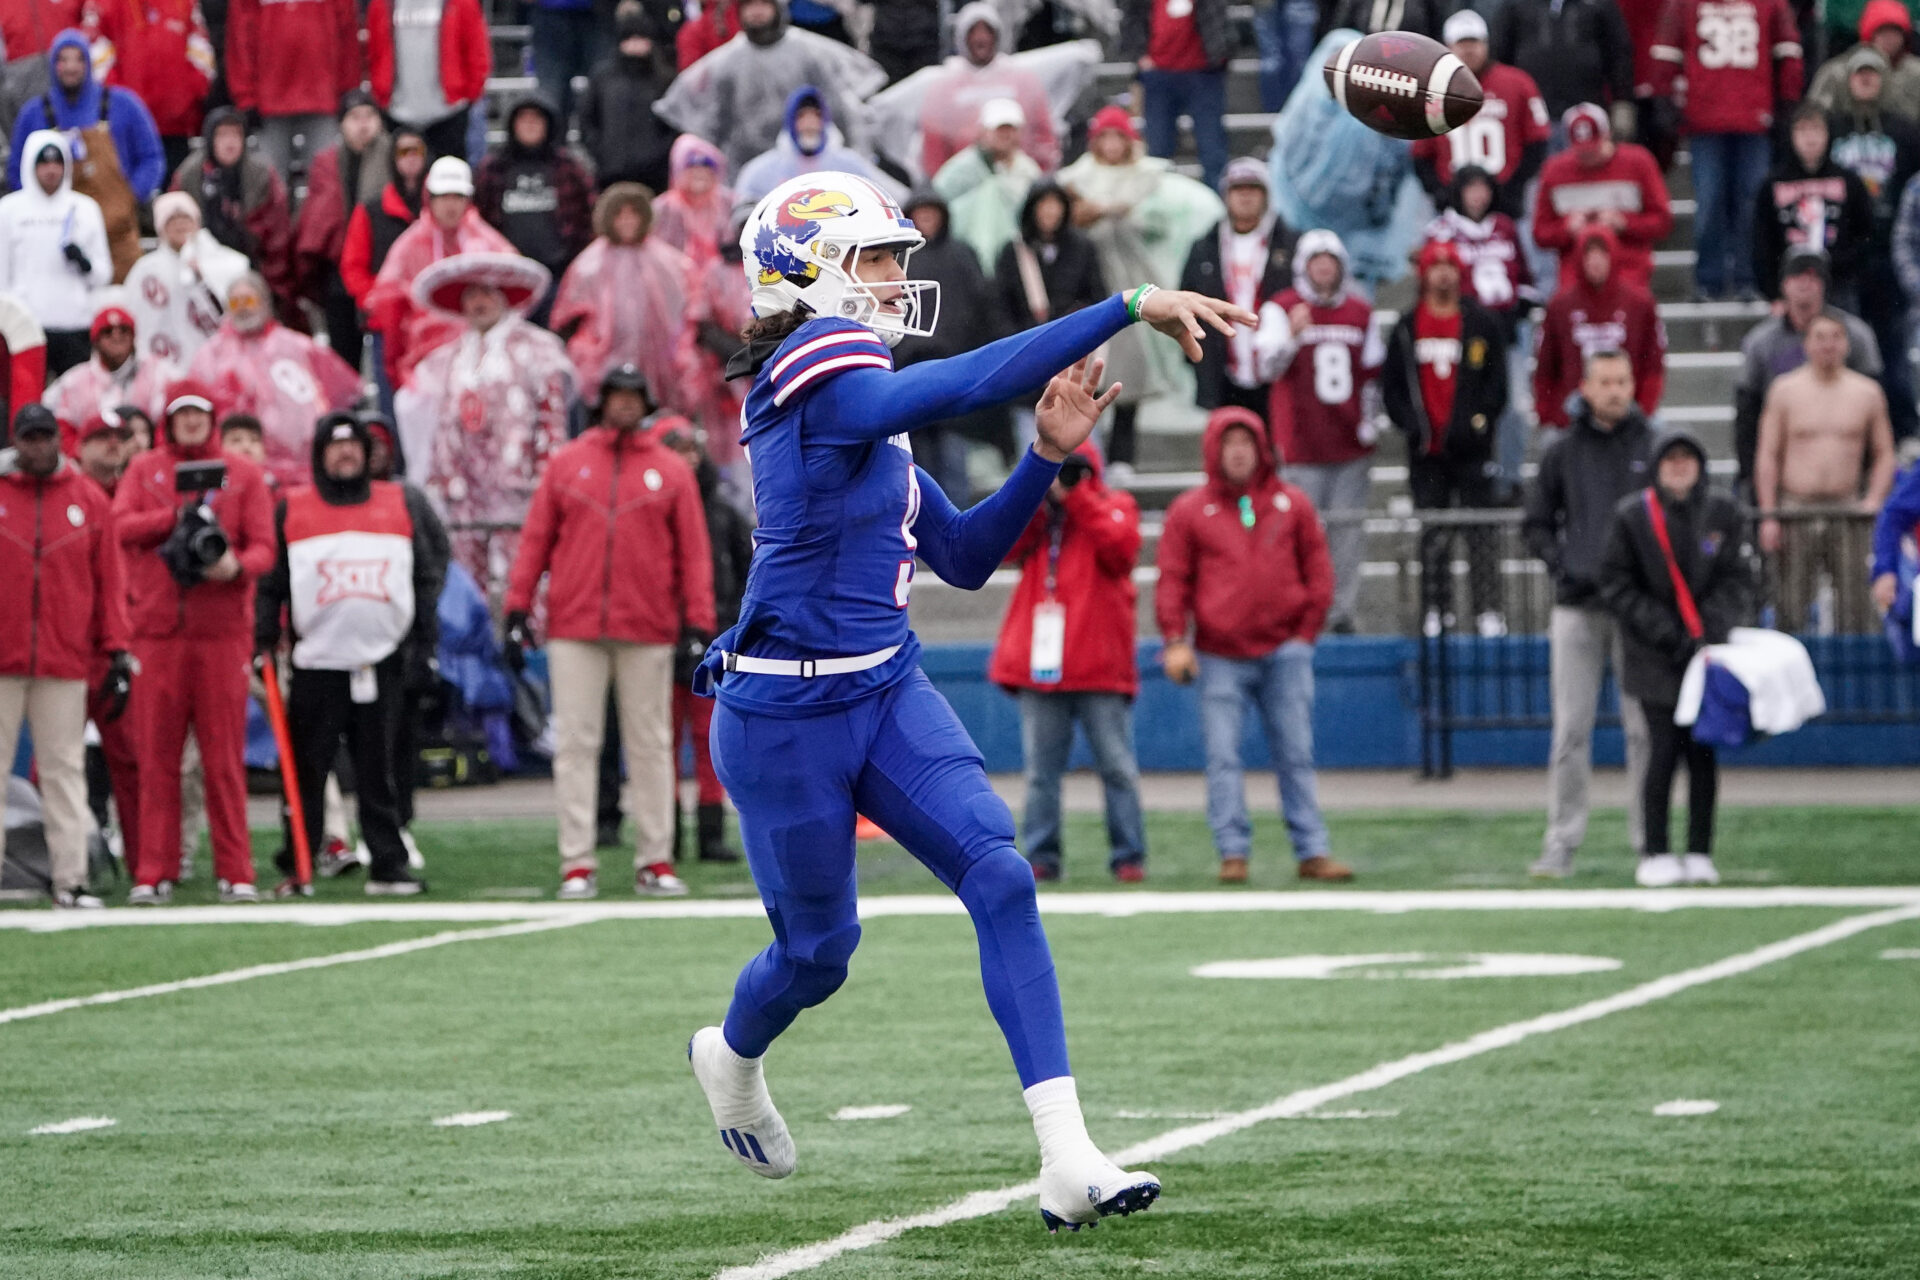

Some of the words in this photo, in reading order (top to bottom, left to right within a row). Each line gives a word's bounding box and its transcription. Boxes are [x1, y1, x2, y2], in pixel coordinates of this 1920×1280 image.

[1696, 14, 1761, 70] 38
[1446, 118, 1507, 176] 10
[1313, 341, 1354, 405] 8
